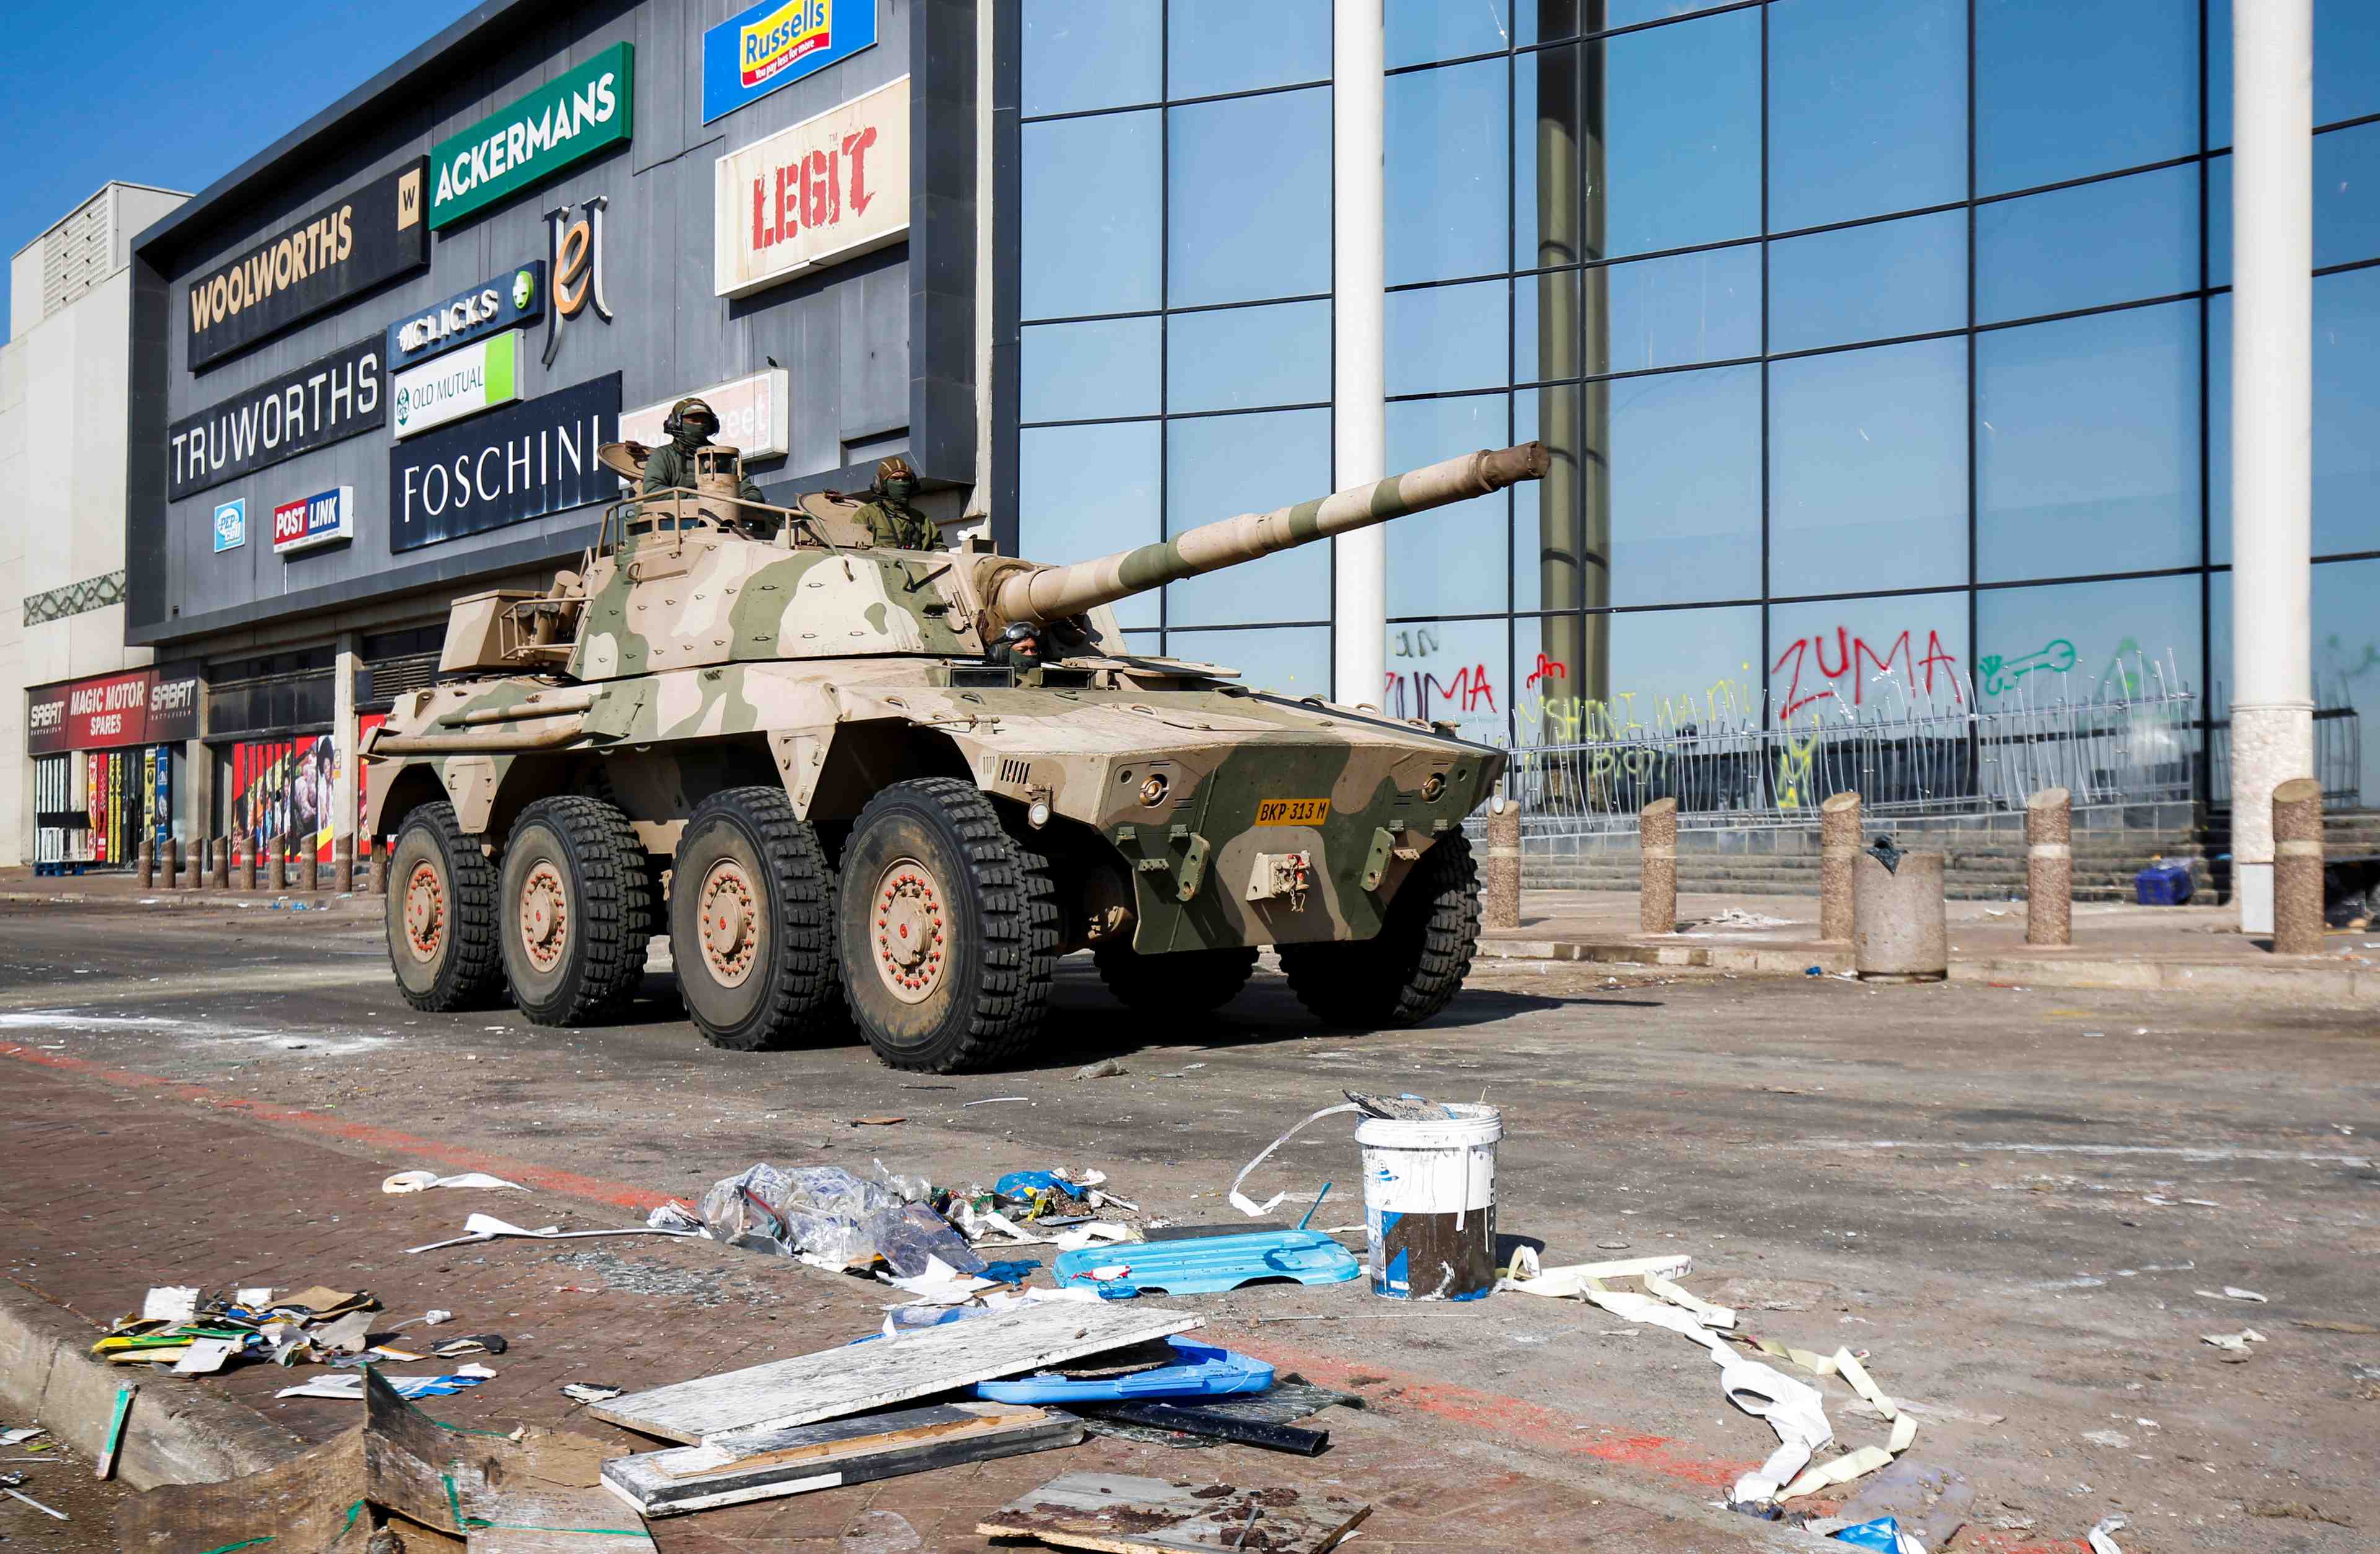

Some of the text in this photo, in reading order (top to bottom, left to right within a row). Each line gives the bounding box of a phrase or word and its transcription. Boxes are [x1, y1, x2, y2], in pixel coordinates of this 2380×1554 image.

[746, 0, 824, 64] Russells
[755, 39, 815, 79] You pay less for more
[434, 72, 615, 208] ACKERMANS
[402, 185, 416, 212] W
[752, 126, 878, 251] LEGIT
[192, 205, 353, 333] WOOLWORTHS
[412, 289, 500, 348] CLICKS
[412, 365, 483, 410] OLD MUTUAL
[172, 353, 378, 485] TRUWORTHS
[404, 415, 599, 523] FOSCHINI
[219, 514, 236, 531] PEP
[275, 496, 338, 539] POST LINK
[1771, 625, 1962, 720] ZUMA
[30, 700, 65, 727] SABAT
[70, 681, 144, 716] MAGIC MOTOR
[151, 679, 196, 712] SABAT
[90, 713, 121, 736] SPARES
[1260, 802, 1328, 821] BKP 313 M
